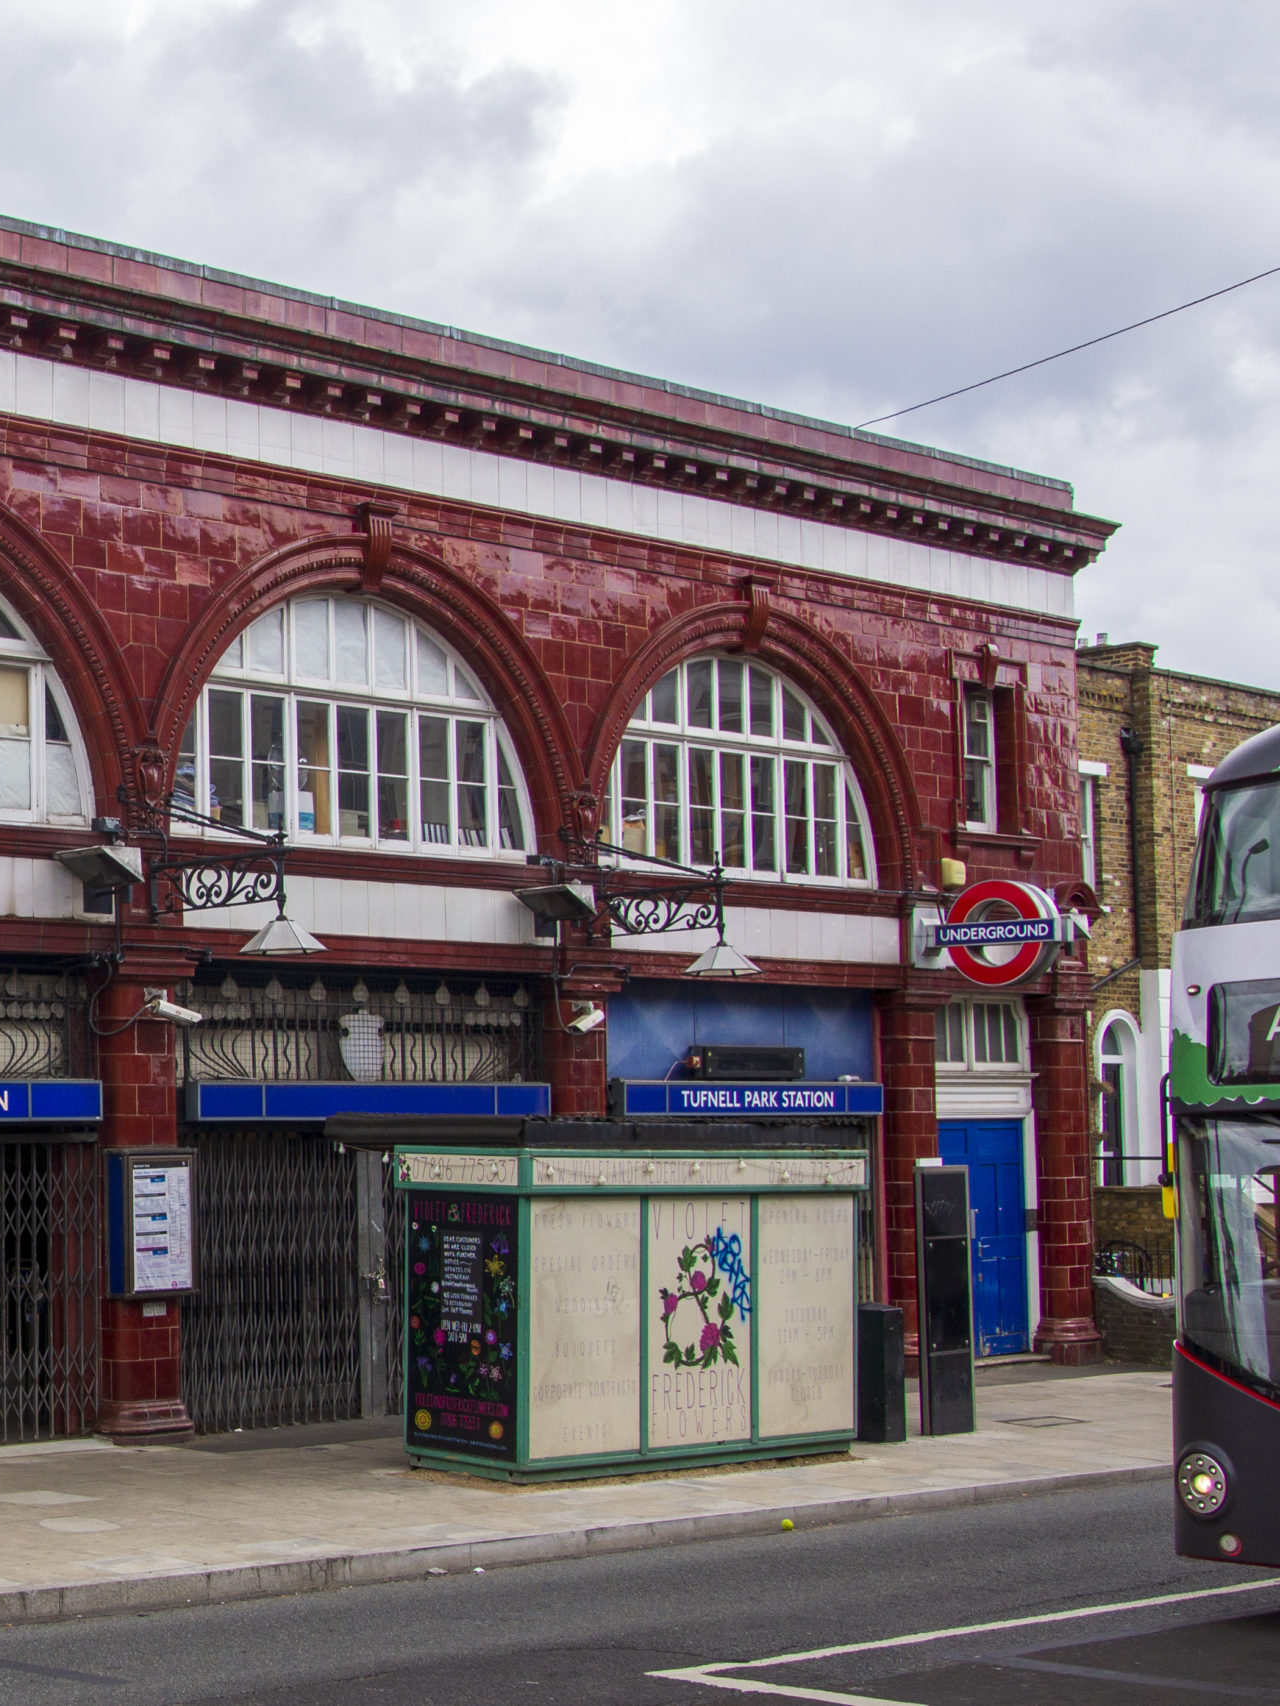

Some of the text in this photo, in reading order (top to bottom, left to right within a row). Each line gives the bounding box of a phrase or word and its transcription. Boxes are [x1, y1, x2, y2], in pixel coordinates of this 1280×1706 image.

[939, 923, 1049, 942] UNDERGROUND
[681, 1090, 834, 1108] TUFNELL PARK STATION
[414, 1200, 446, 1221] VIOLET
[461, 1201, 512, 1225] FREDERICK
[534, 1212, 637, 1230] FRESH FLOWERS
[652, 1201, 746, 1240] VIOLET
[762, 1208, 849, 1225] OPENING HOURS
[534, 1254, 637, 1272] SPECIAL ORDERS
[554, 1339, 616, 1358] BOUQUETS
[534, 1383, 582, 1402] CORPORATE
[652, 1368, 746, 1412] FREDERICK
[652, 1404, 747, 1440] FLOWERS
[562, 1422, 608, 1442] EVENTS
